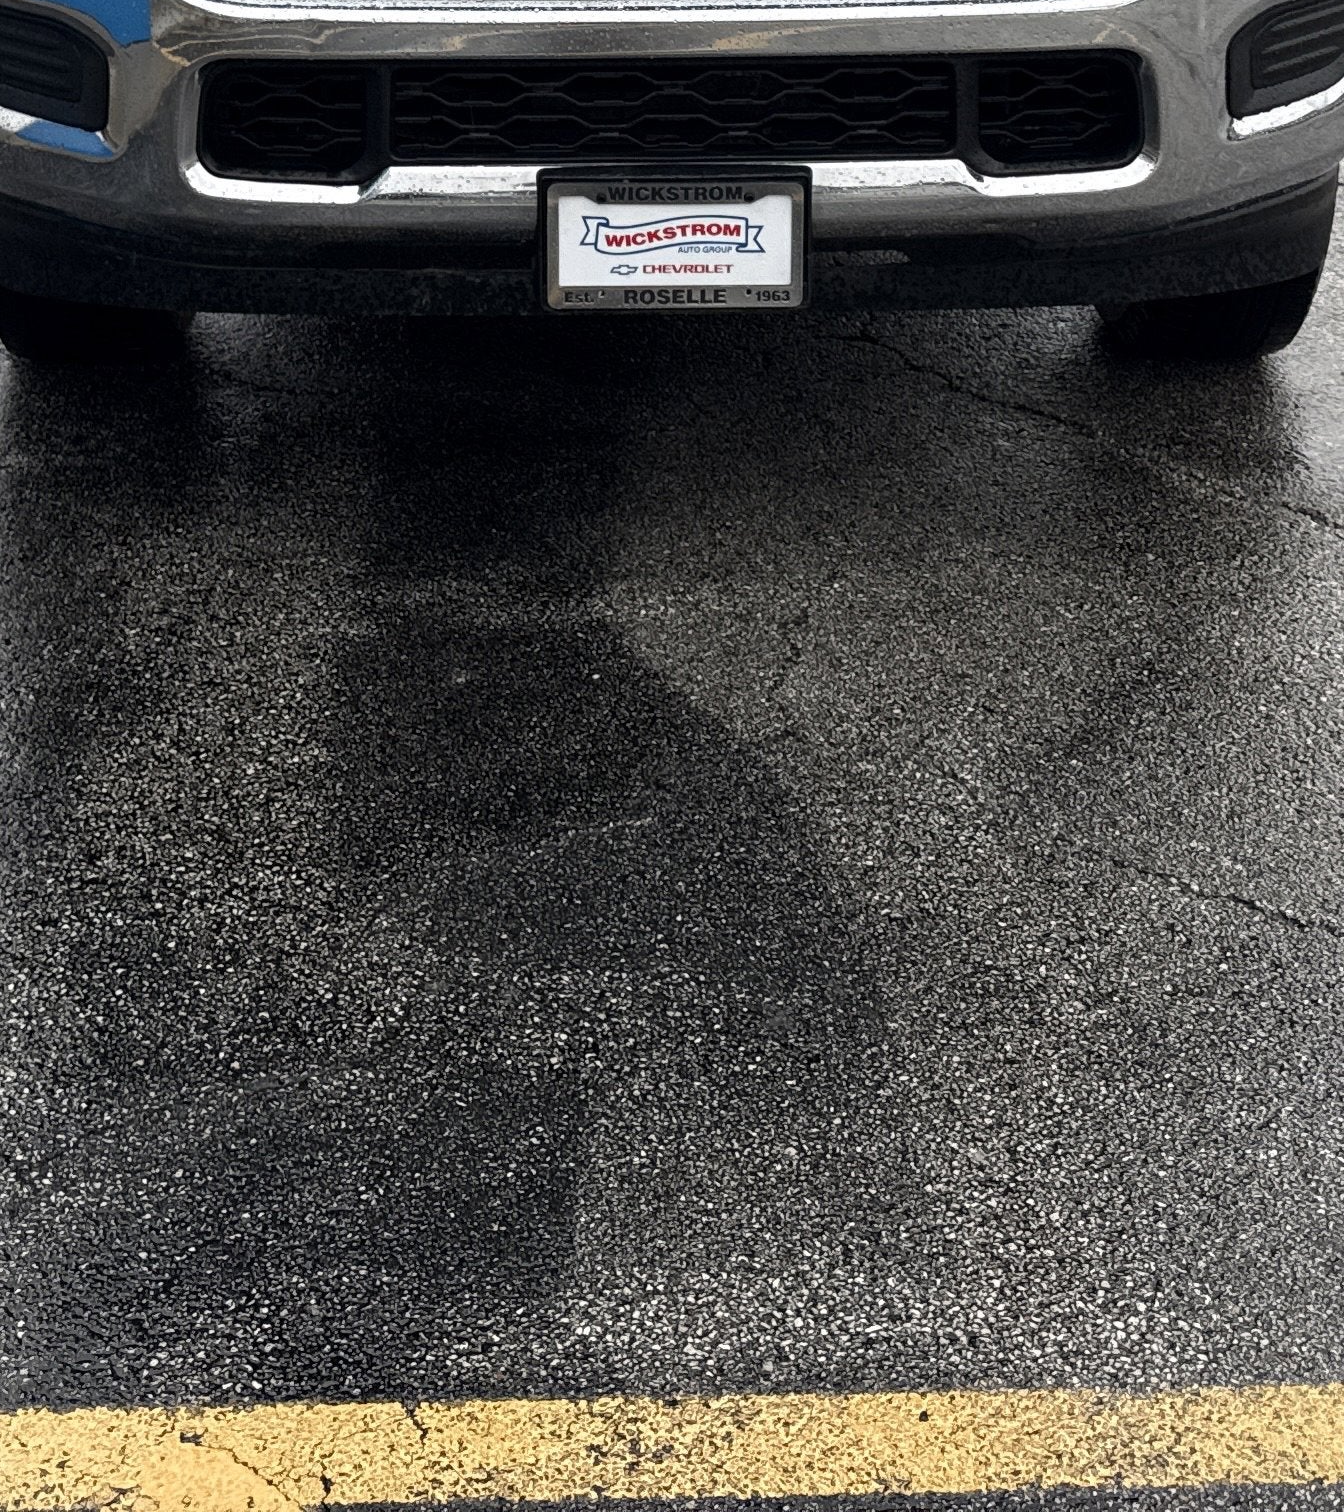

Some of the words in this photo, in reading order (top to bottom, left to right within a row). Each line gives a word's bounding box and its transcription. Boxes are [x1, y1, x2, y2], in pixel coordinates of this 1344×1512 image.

[608, 186, 743, 201] WICKSTROM
[604, 223, 742, 248] WICKSTROM
[678, 246, 701, 254] AUTO
[702, 246, 733, 254] GROUP
[642, 264, 734, 274] CHEVROLET
[564, 291, 595, 303] Est.
[623, 289, 727, 304] ROSELLE
[755, 290, 791, 302] 1963
